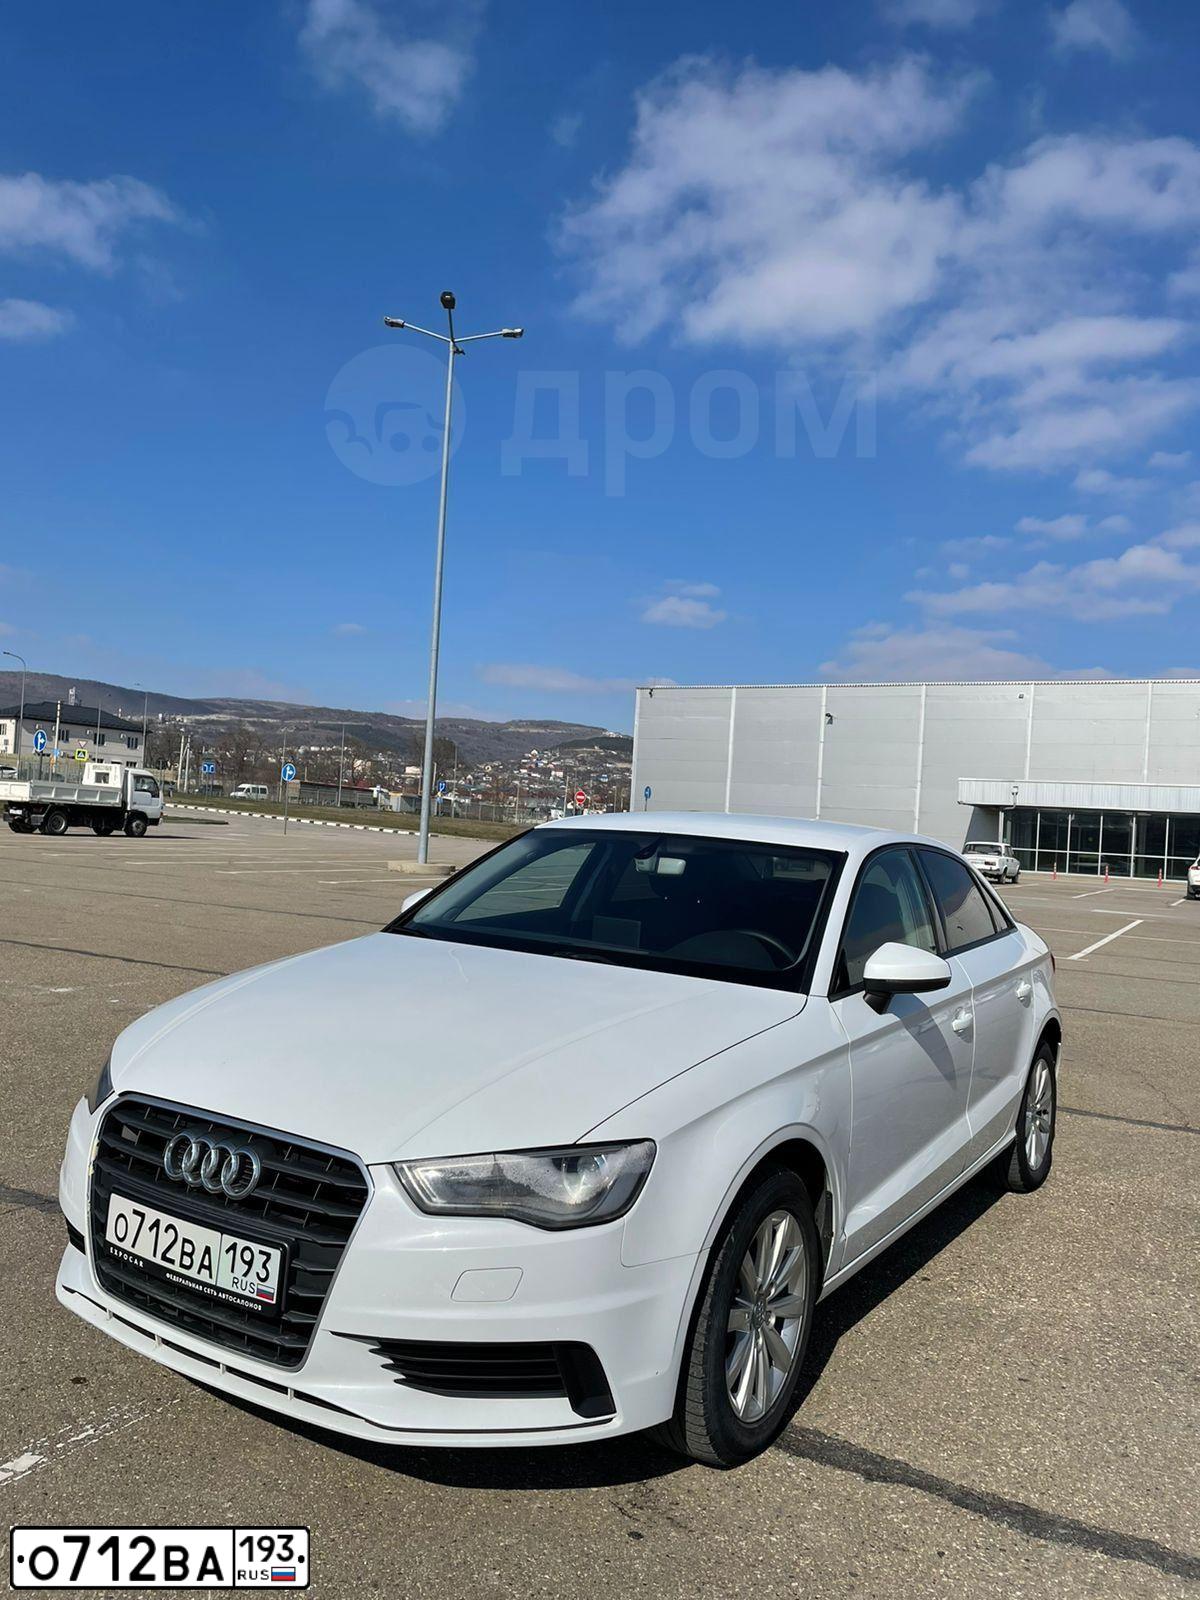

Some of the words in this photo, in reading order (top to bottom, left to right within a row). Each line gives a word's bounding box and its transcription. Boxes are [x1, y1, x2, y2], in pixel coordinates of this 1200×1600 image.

[225, 1241, 272, 1283] 193
[231, 1276, 256, 1294] RUS
[217, 1291, 262, 1311] АВТОСАЛОНОВ
